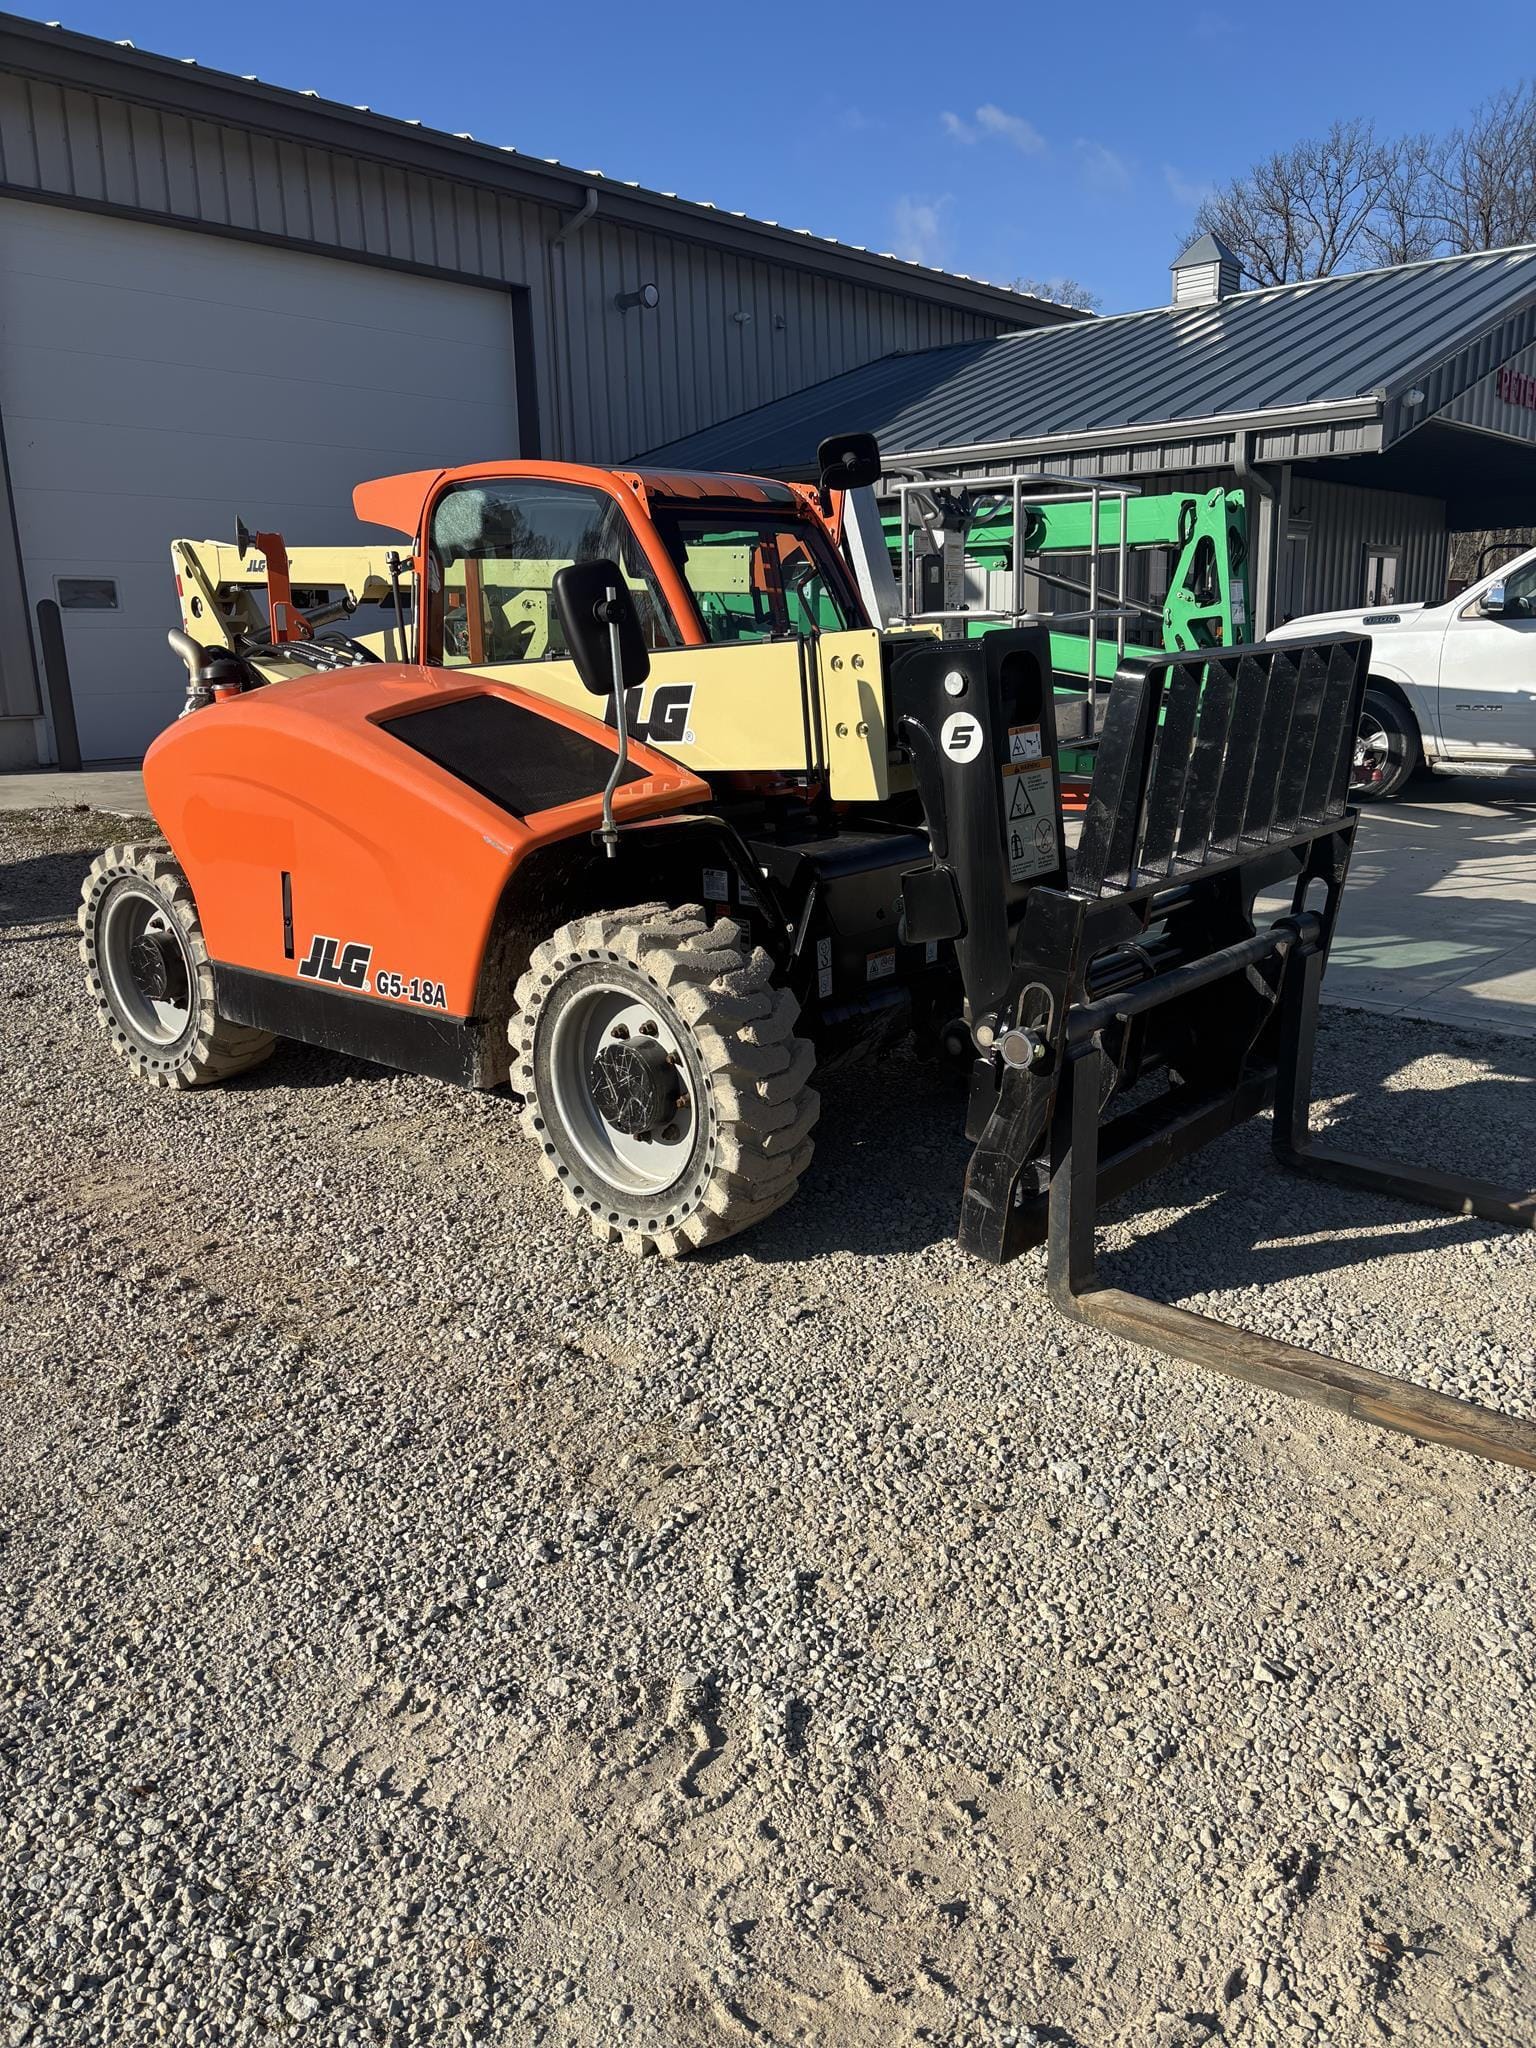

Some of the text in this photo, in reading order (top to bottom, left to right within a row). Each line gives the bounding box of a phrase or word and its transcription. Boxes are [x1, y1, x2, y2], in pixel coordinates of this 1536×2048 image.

[949, 725, 976, 750] 5
[298, 935, 448, 1011] JLG G5-18A
